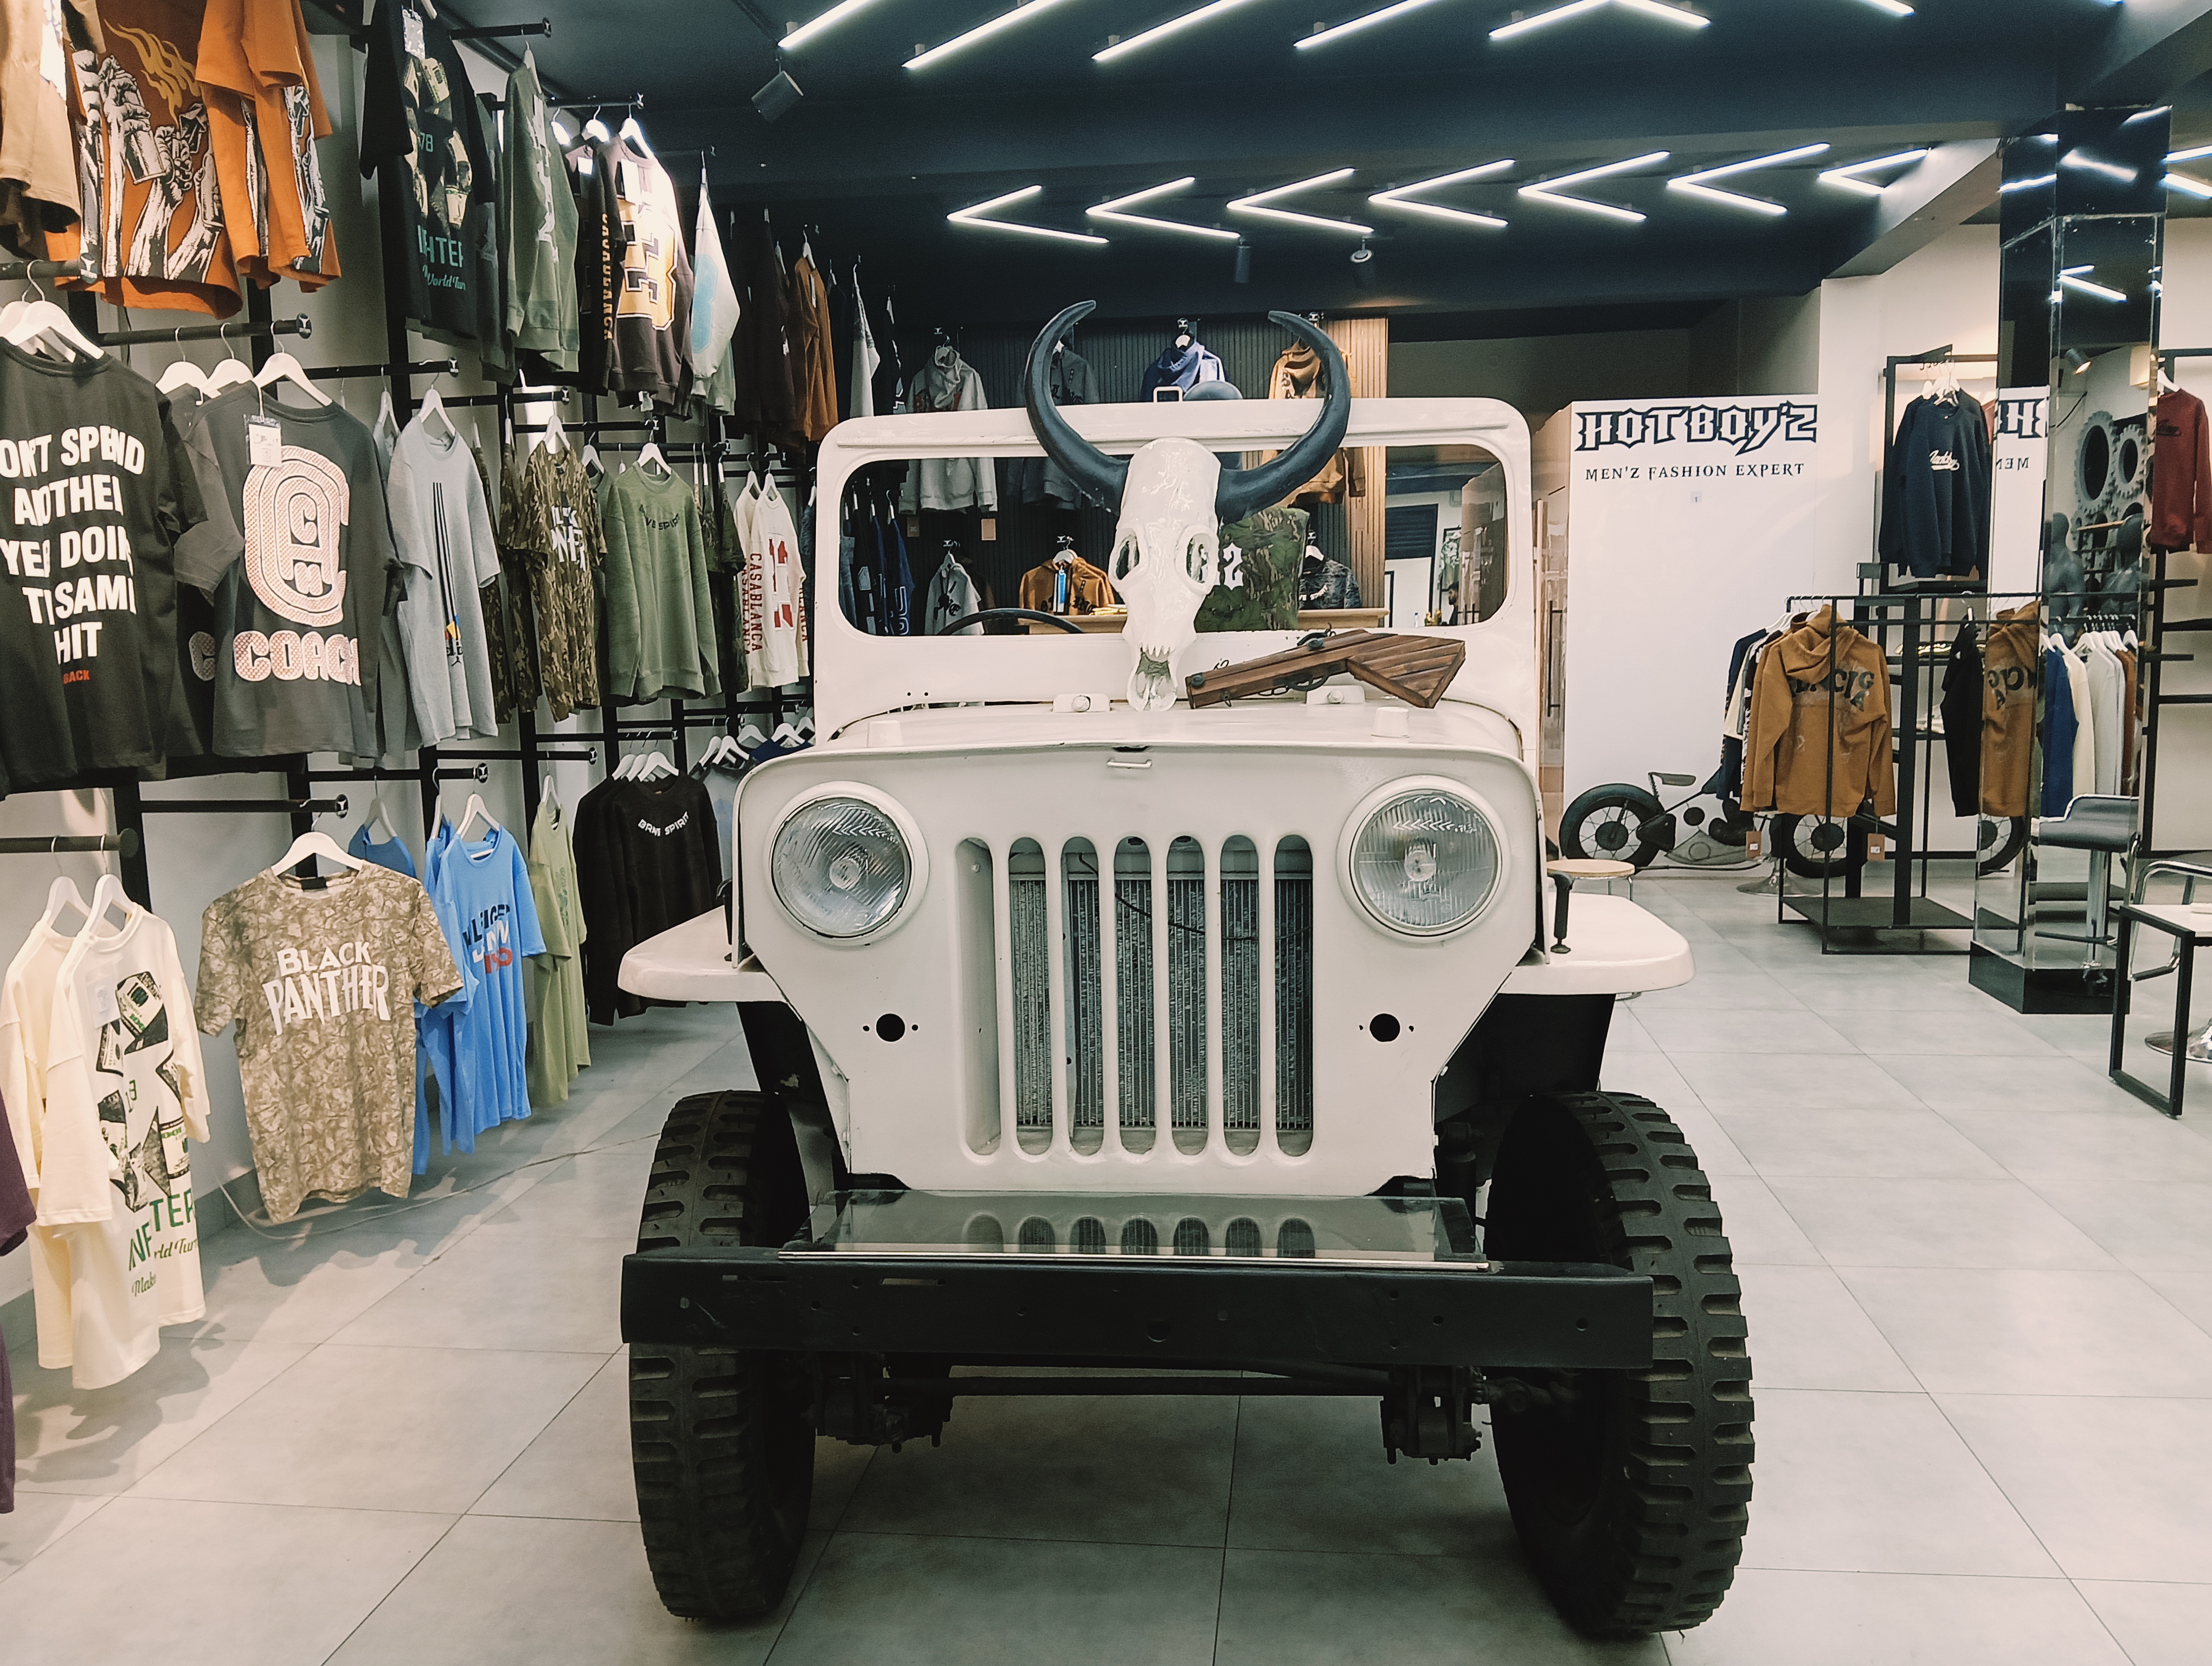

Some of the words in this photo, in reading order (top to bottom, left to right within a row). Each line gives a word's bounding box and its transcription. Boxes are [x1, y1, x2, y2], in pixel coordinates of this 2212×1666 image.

[1585, 465, 1640, 482] MEN'Z
[1648, 464, 1727, 482] FASHION
[1735, 463, 1804, 478] EXPERT
[750, 553, 763, 651] CASABLANCA
[276, 941, 371, 977] BLACK
[262, 964, 391, 1036] PANTHER
